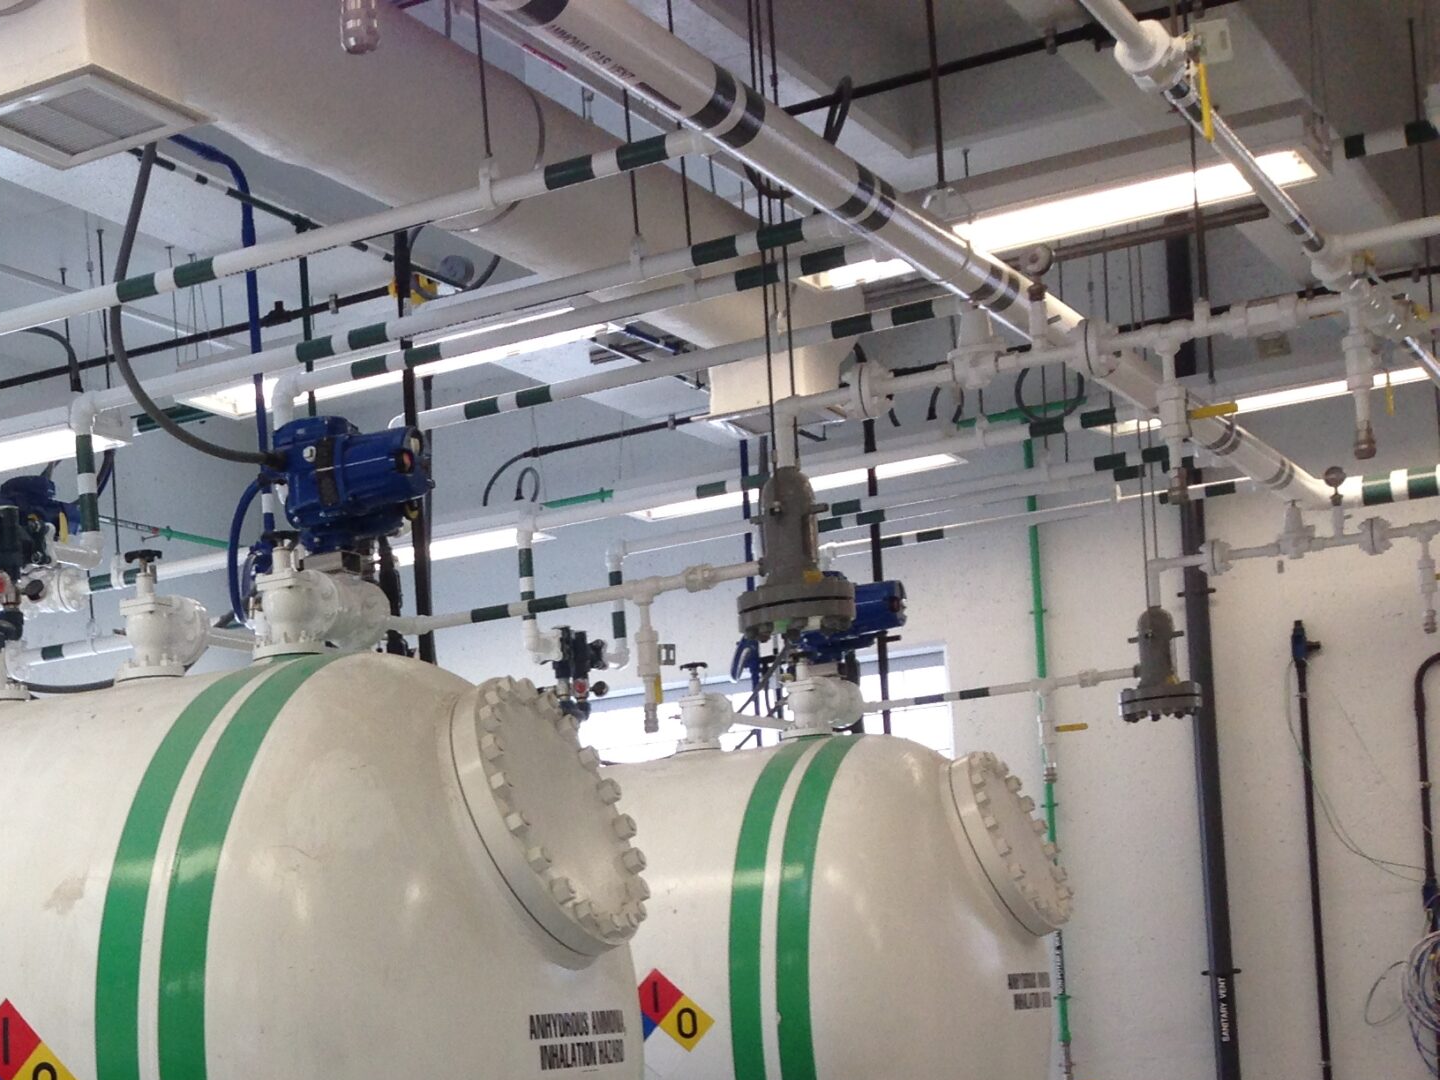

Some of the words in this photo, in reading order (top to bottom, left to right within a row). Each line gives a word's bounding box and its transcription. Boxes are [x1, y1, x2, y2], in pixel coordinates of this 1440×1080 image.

[1217, 976, 1227, 999] VENT
[529, 1011, 589, 1040] ANHYDROUS
[1220, 1002, 1231, 1042] SANITARY
[539, 1041, 597, 1070] INHALATION
